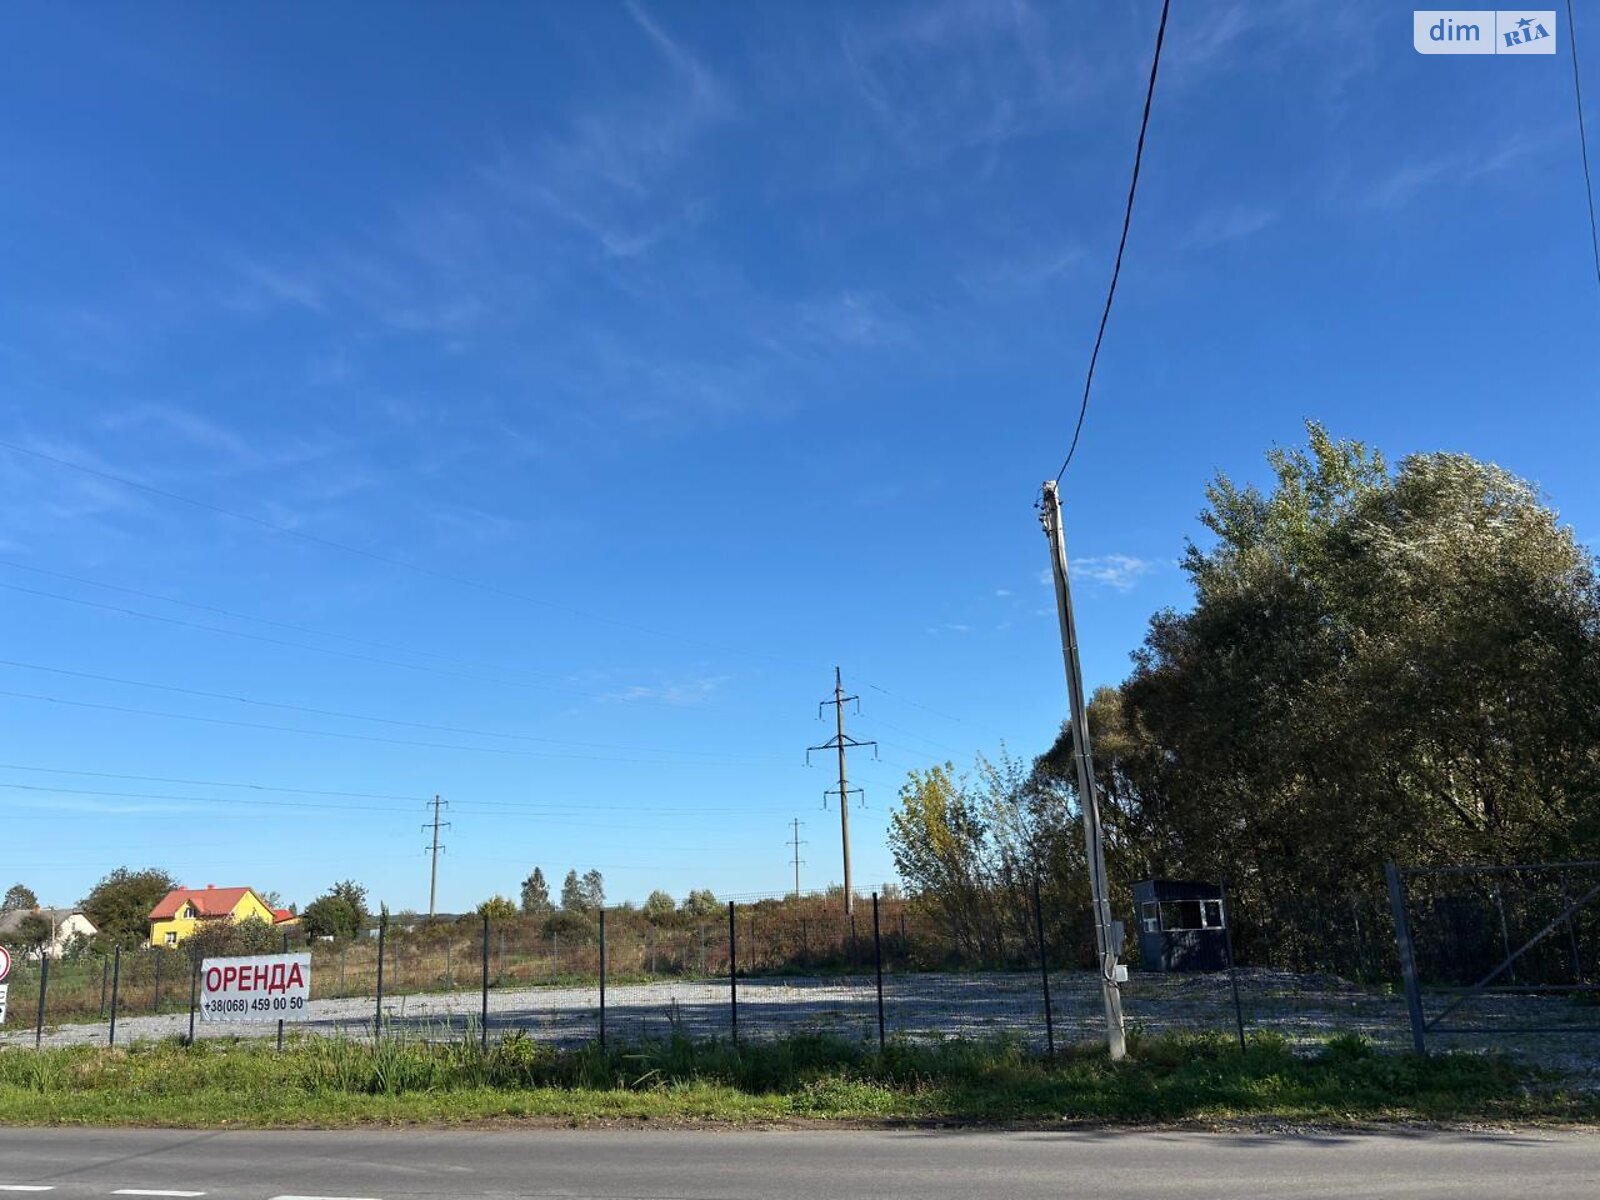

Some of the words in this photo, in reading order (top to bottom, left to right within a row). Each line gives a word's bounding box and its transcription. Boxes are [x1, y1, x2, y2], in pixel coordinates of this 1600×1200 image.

[206, 962, 304, 995] ОРЕНДА
[204, 998, 249, 1015] +38(068)
[251, 998, 270, 1011] 459
[273, 997, 287, 1010] 00
[290, 996, 303, 1010] 50
